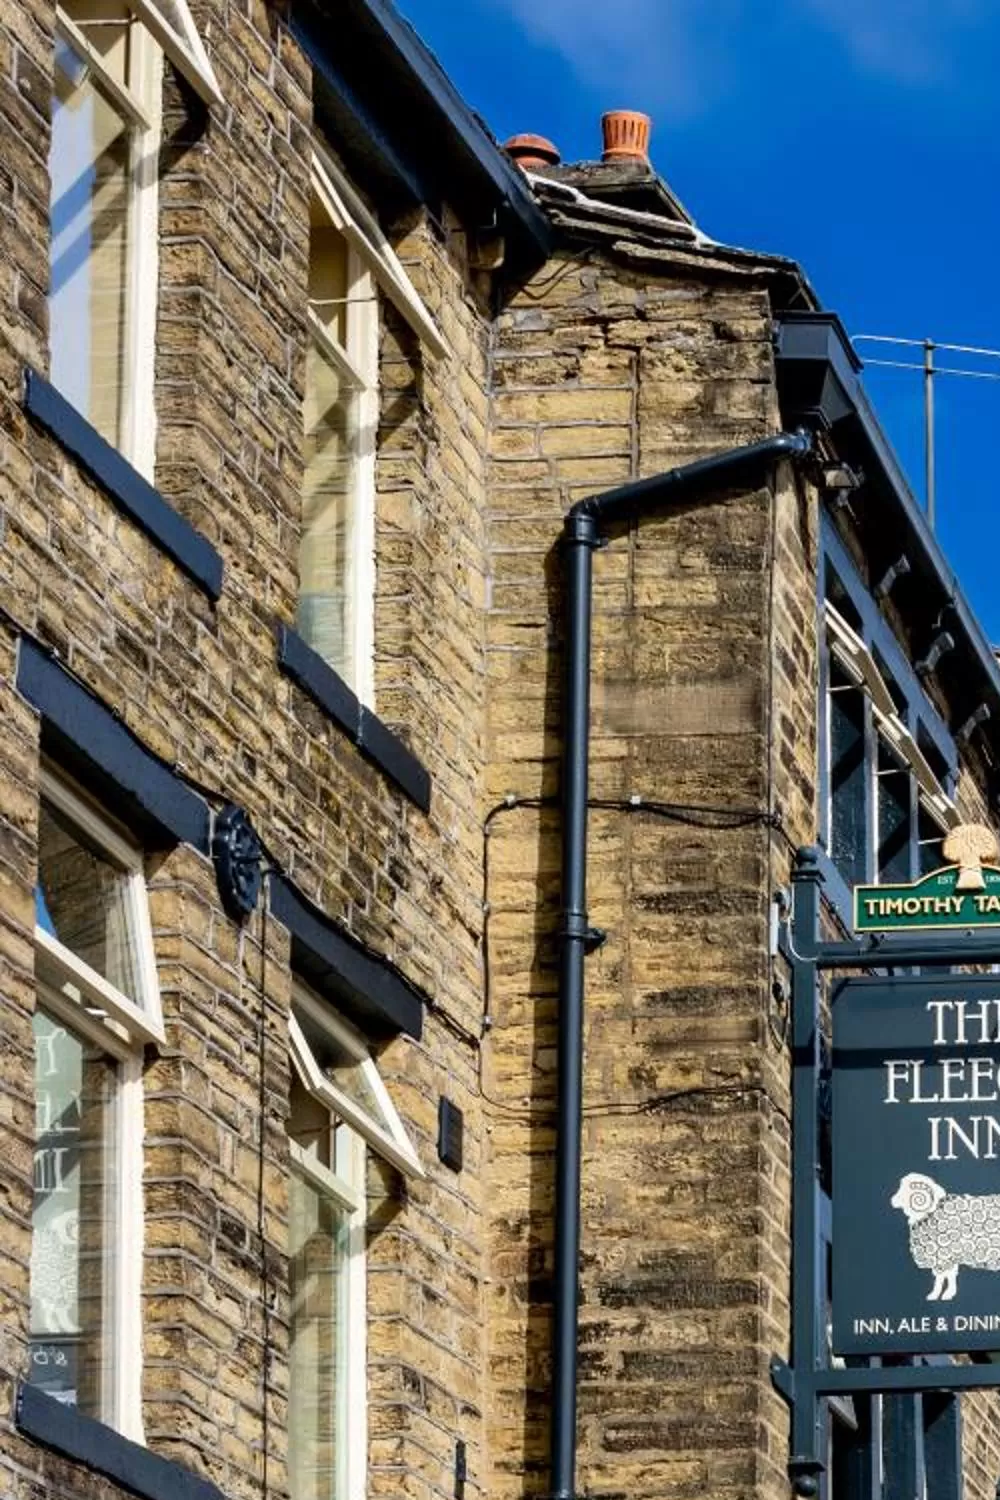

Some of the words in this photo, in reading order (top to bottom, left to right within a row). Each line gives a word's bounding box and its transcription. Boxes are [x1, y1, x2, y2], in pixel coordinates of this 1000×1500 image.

[866, 897, 963, 915] TIMOTHY
[898, 1317, 931, 1333] ALE
[936, 1316, 948, 1331] &
